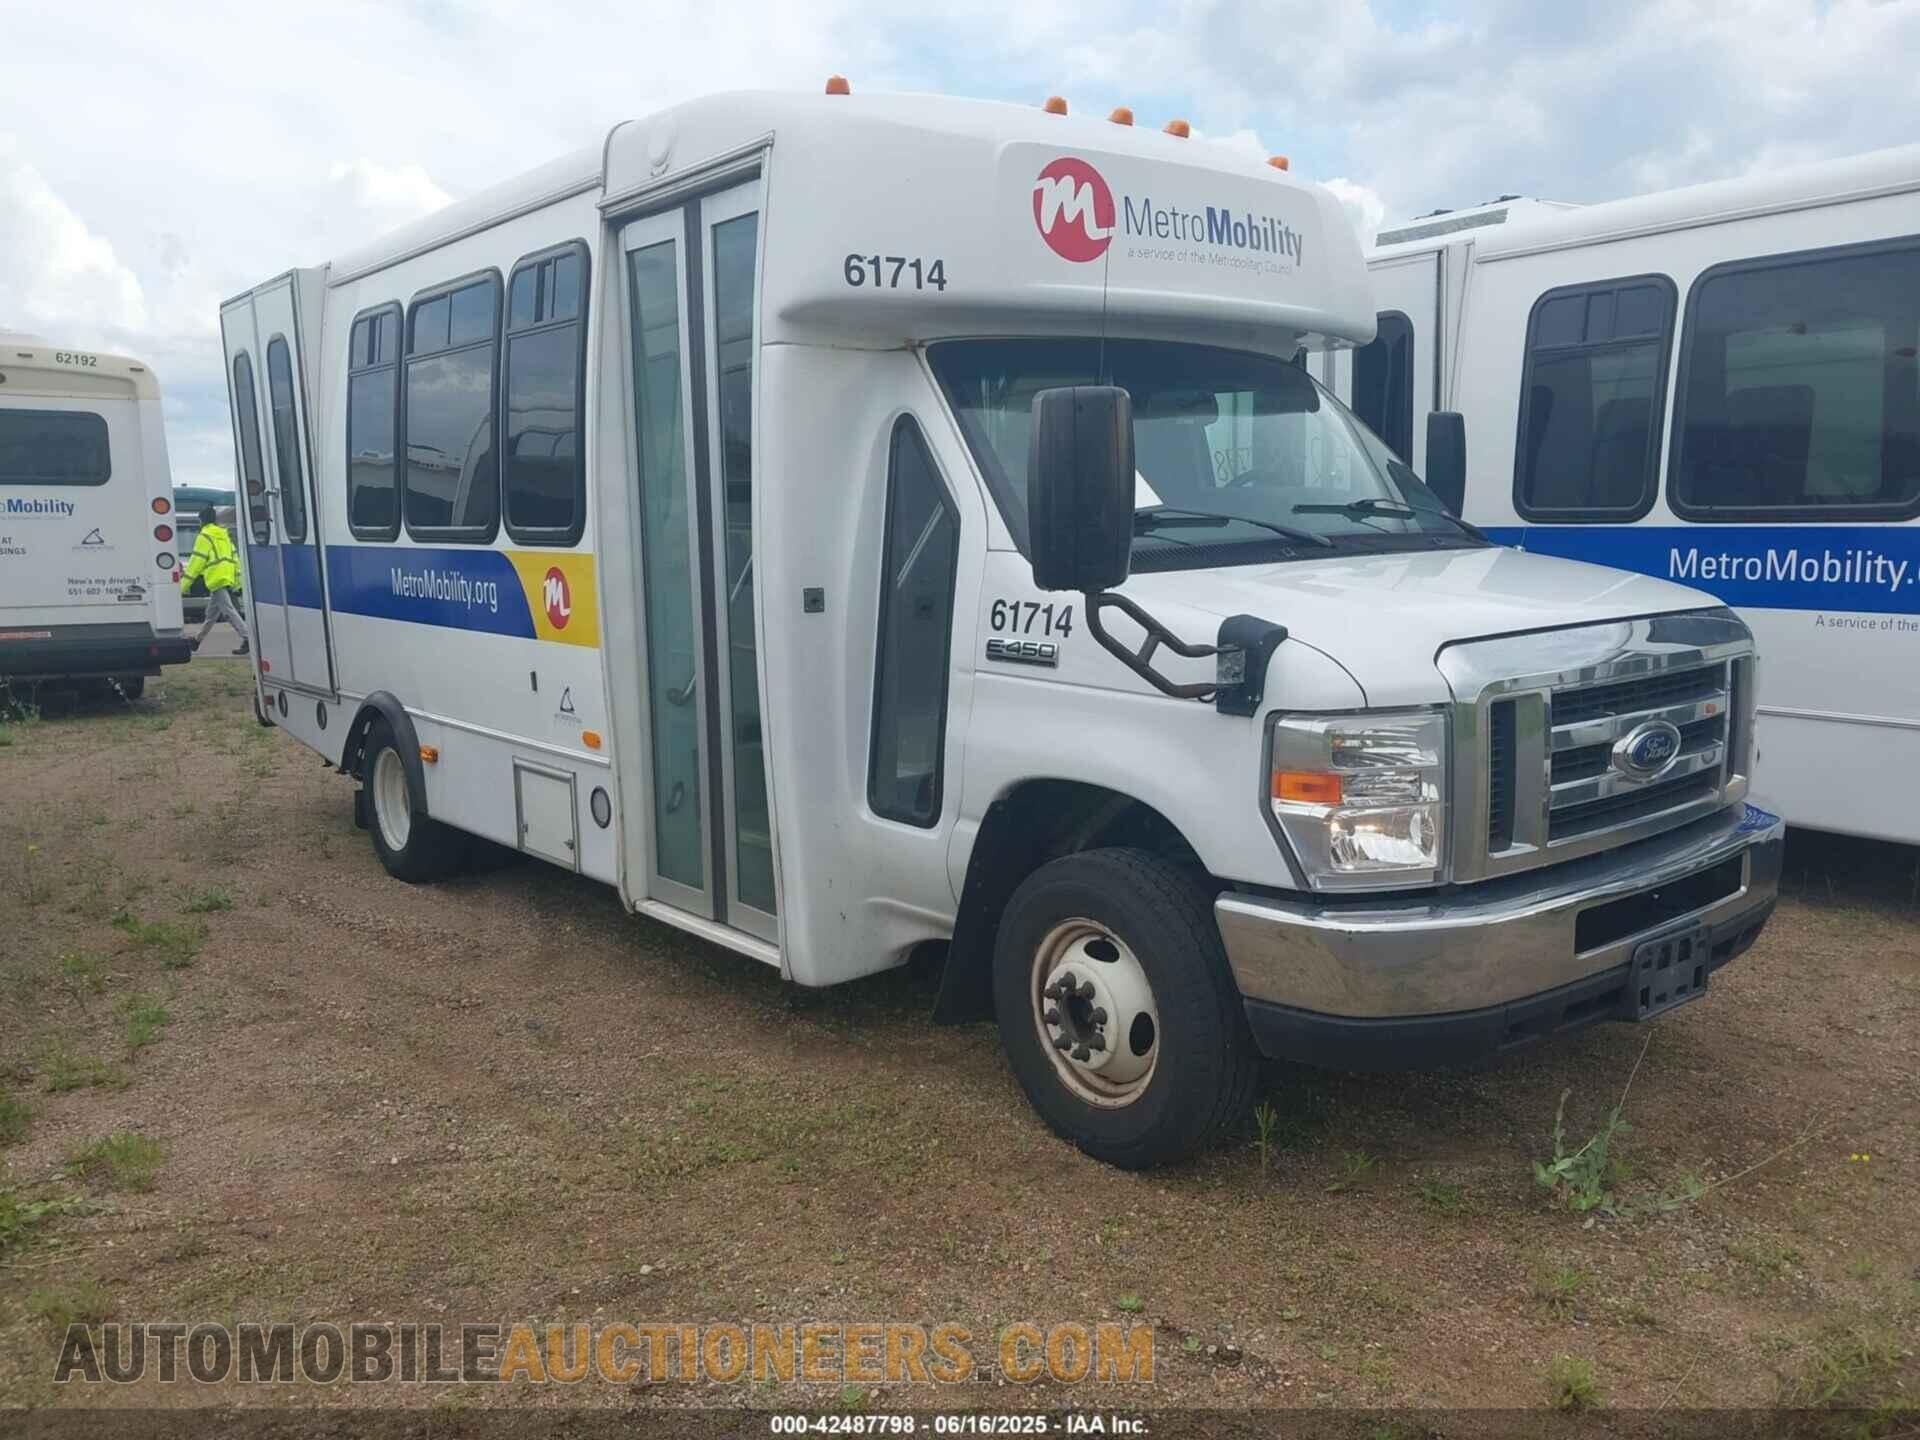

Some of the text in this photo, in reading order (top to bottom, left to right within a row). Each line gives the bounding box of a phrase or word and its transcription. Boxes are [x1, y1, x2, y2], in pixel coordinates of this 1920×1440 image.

[1124, 195, 1302, 267] MetroMobility
[844, 253, 947, 291] 61714
[1137, 247, 1175, 261] service
[1177, 250, 1188, 262] of
[1190, 251, 1207, 264] the
[1208, 254, 1263, 276] Metropolitan
[55, 352, 97, 367] 62192
[67, 576, 140, 587] How's my driving?
[391, 567, 499, 613] MetroMobility.org
[990, 598, 1073, 638] 61714
[1816, 615, 1919, 632] A service of the
